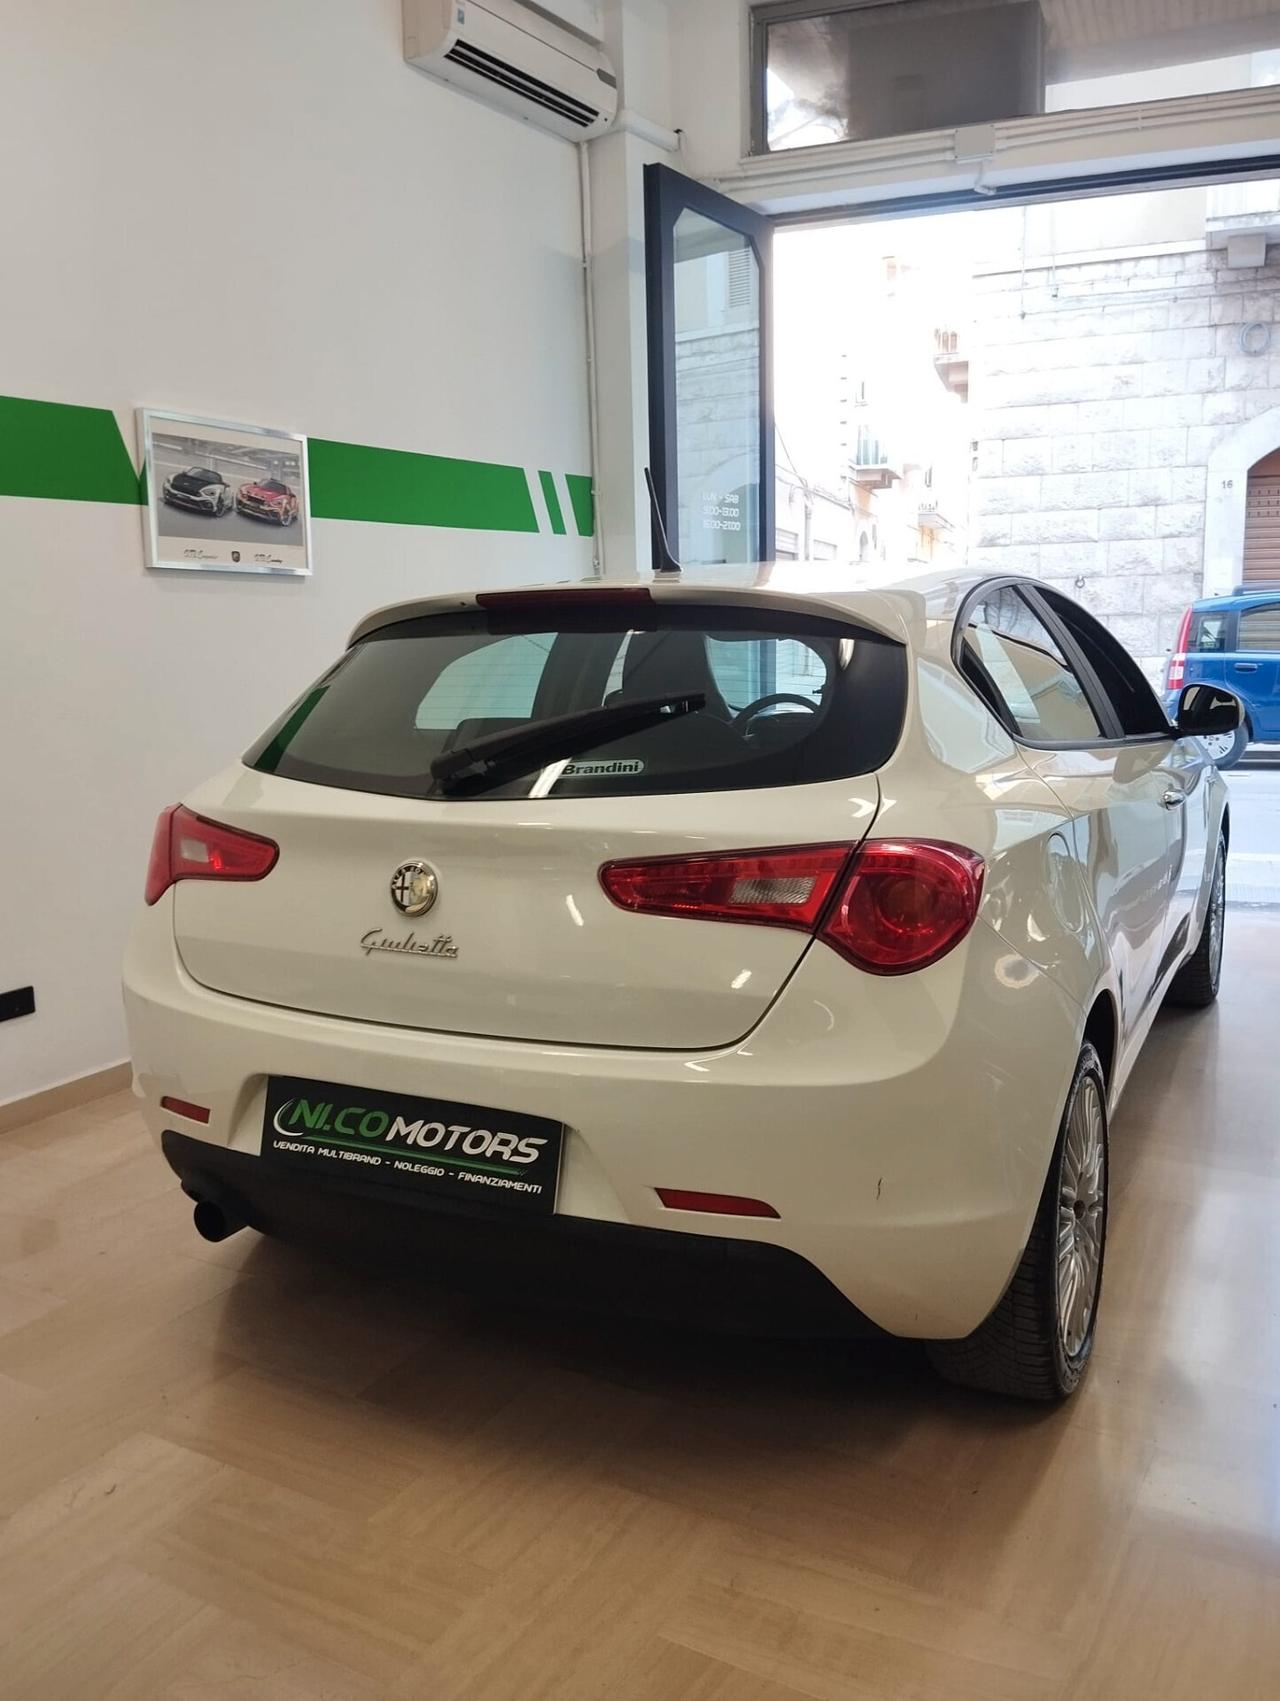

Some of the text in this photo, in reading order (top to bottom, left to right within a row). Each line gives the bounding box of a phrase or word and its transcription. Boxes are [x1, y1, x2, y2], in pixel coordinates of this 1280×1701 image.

[1222, 480, 1233, 489] 16
[562, 761, 639, 775] Brandini
[360, 928, 459, 959] Giulietta
[385, 1115, 548, 1164] MOTORS
[273, 1140, 315, 1154] VENDITA
[317, 1147, 382, 1166] MULTIBRAND
[394, 1160, 445, 1177] NOLEGGIO
[457, 1171, 542, 1194] FINANZIAMENTI
